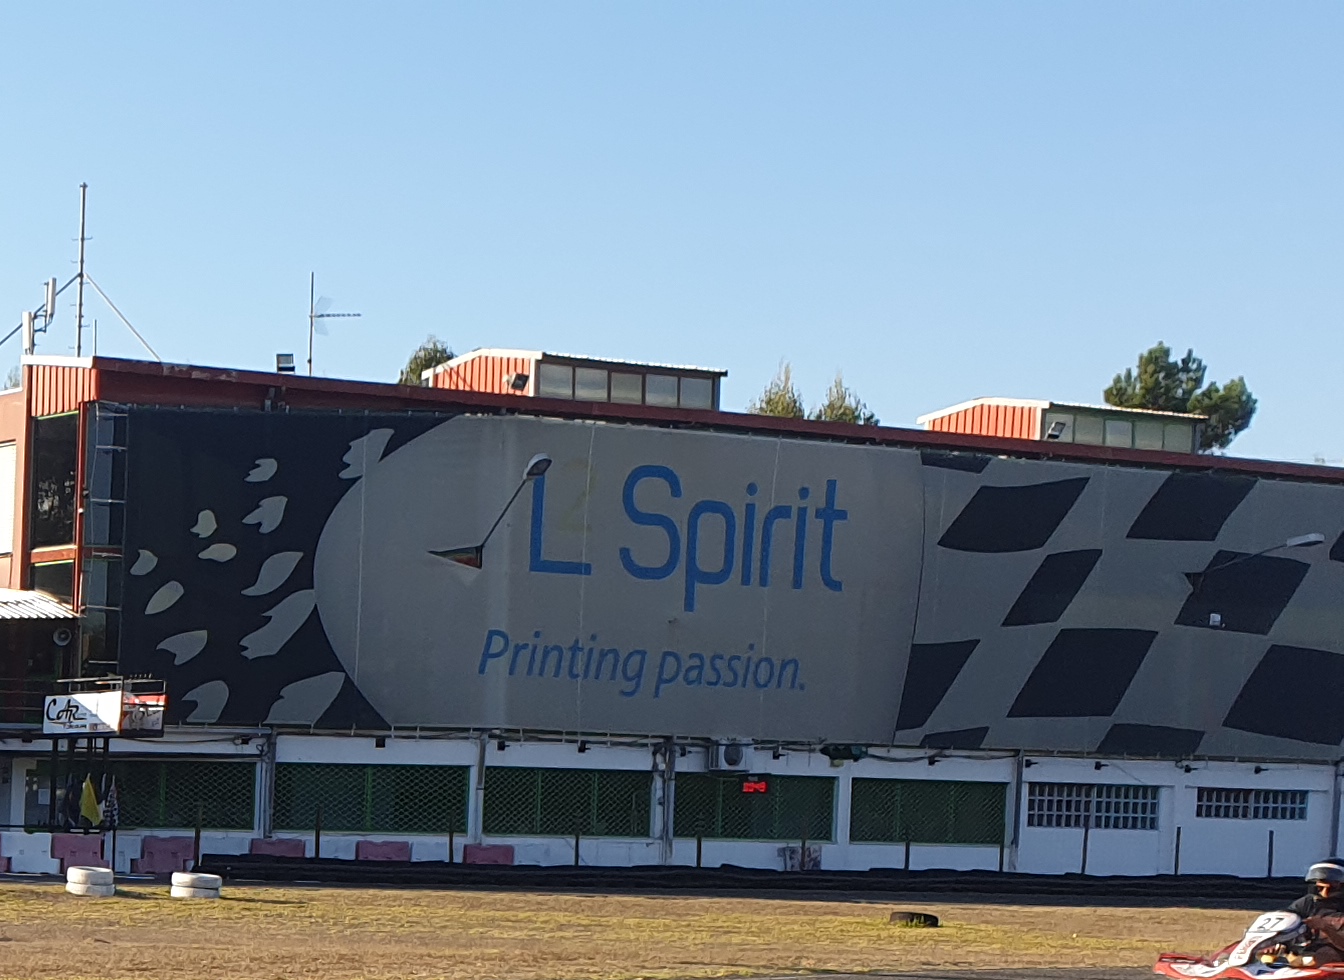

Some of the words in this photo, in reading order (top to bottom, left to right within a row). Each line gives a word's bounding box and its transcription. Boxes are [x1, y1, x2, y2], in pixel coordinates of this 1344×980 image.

[619, 464, 848, 612] Spirit
[478, 629, 647, 699] Printing
[653, 643, 806, 699] passion.
[1257, 917, 1285, 931] 27
